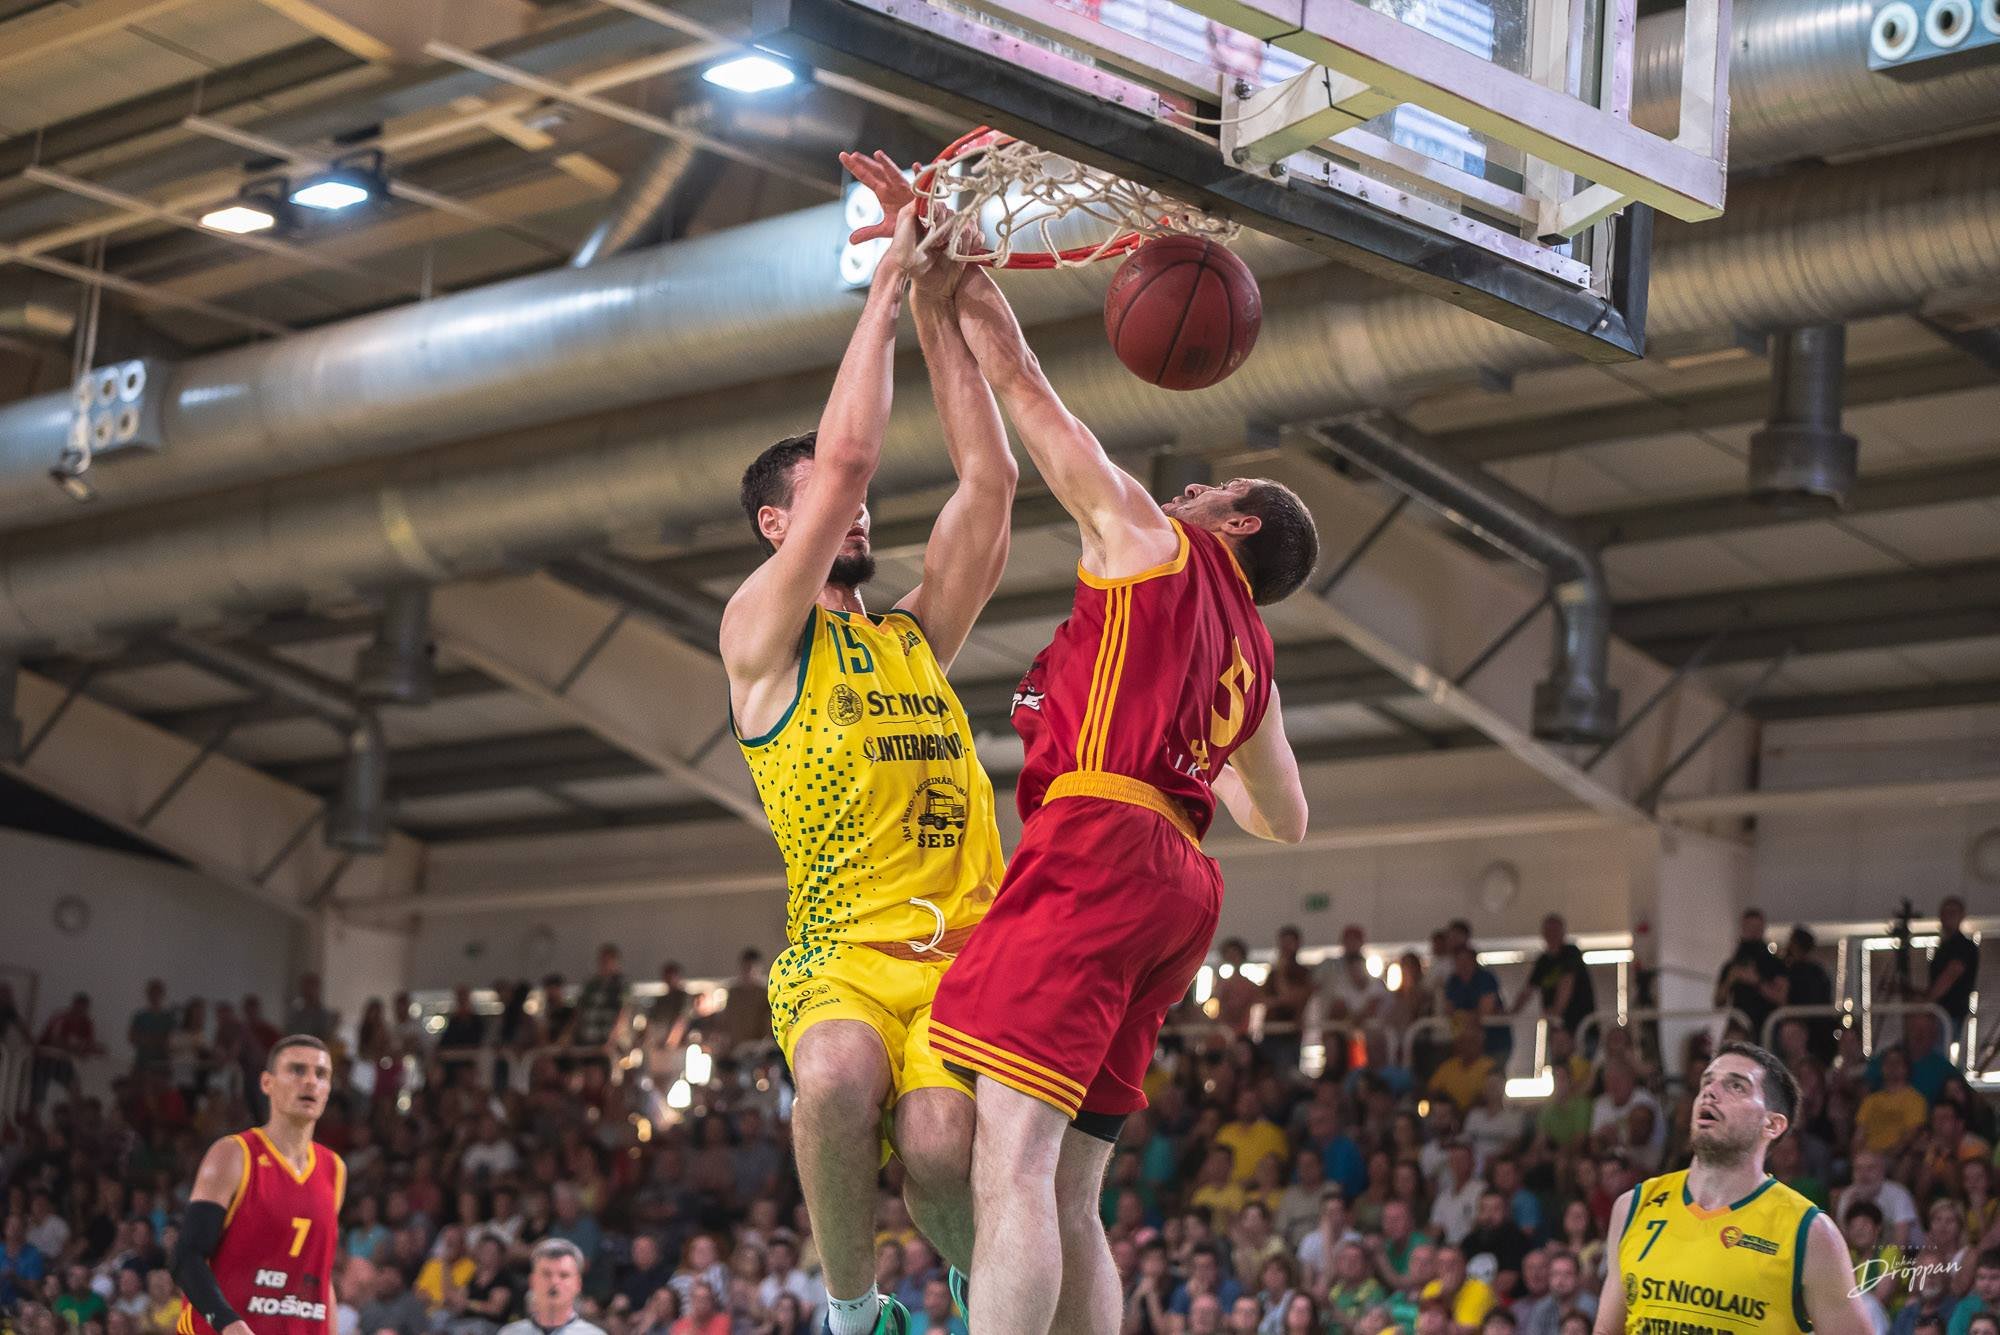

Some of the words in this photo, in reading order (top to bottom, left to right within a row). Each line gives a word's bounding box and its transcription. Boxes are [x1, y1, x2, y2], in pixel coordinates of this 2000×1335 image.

[826, 620, 874, 675] 15
[289, 1217, 312, 1257] 7
[1636, 1219, 1670, 1262] 7
[256, 1269, 288, 1288] KB
[248, 1295, 327, 1320] KOŠICE
[1667, 1279, 1768, 1321] NICOLAUS
